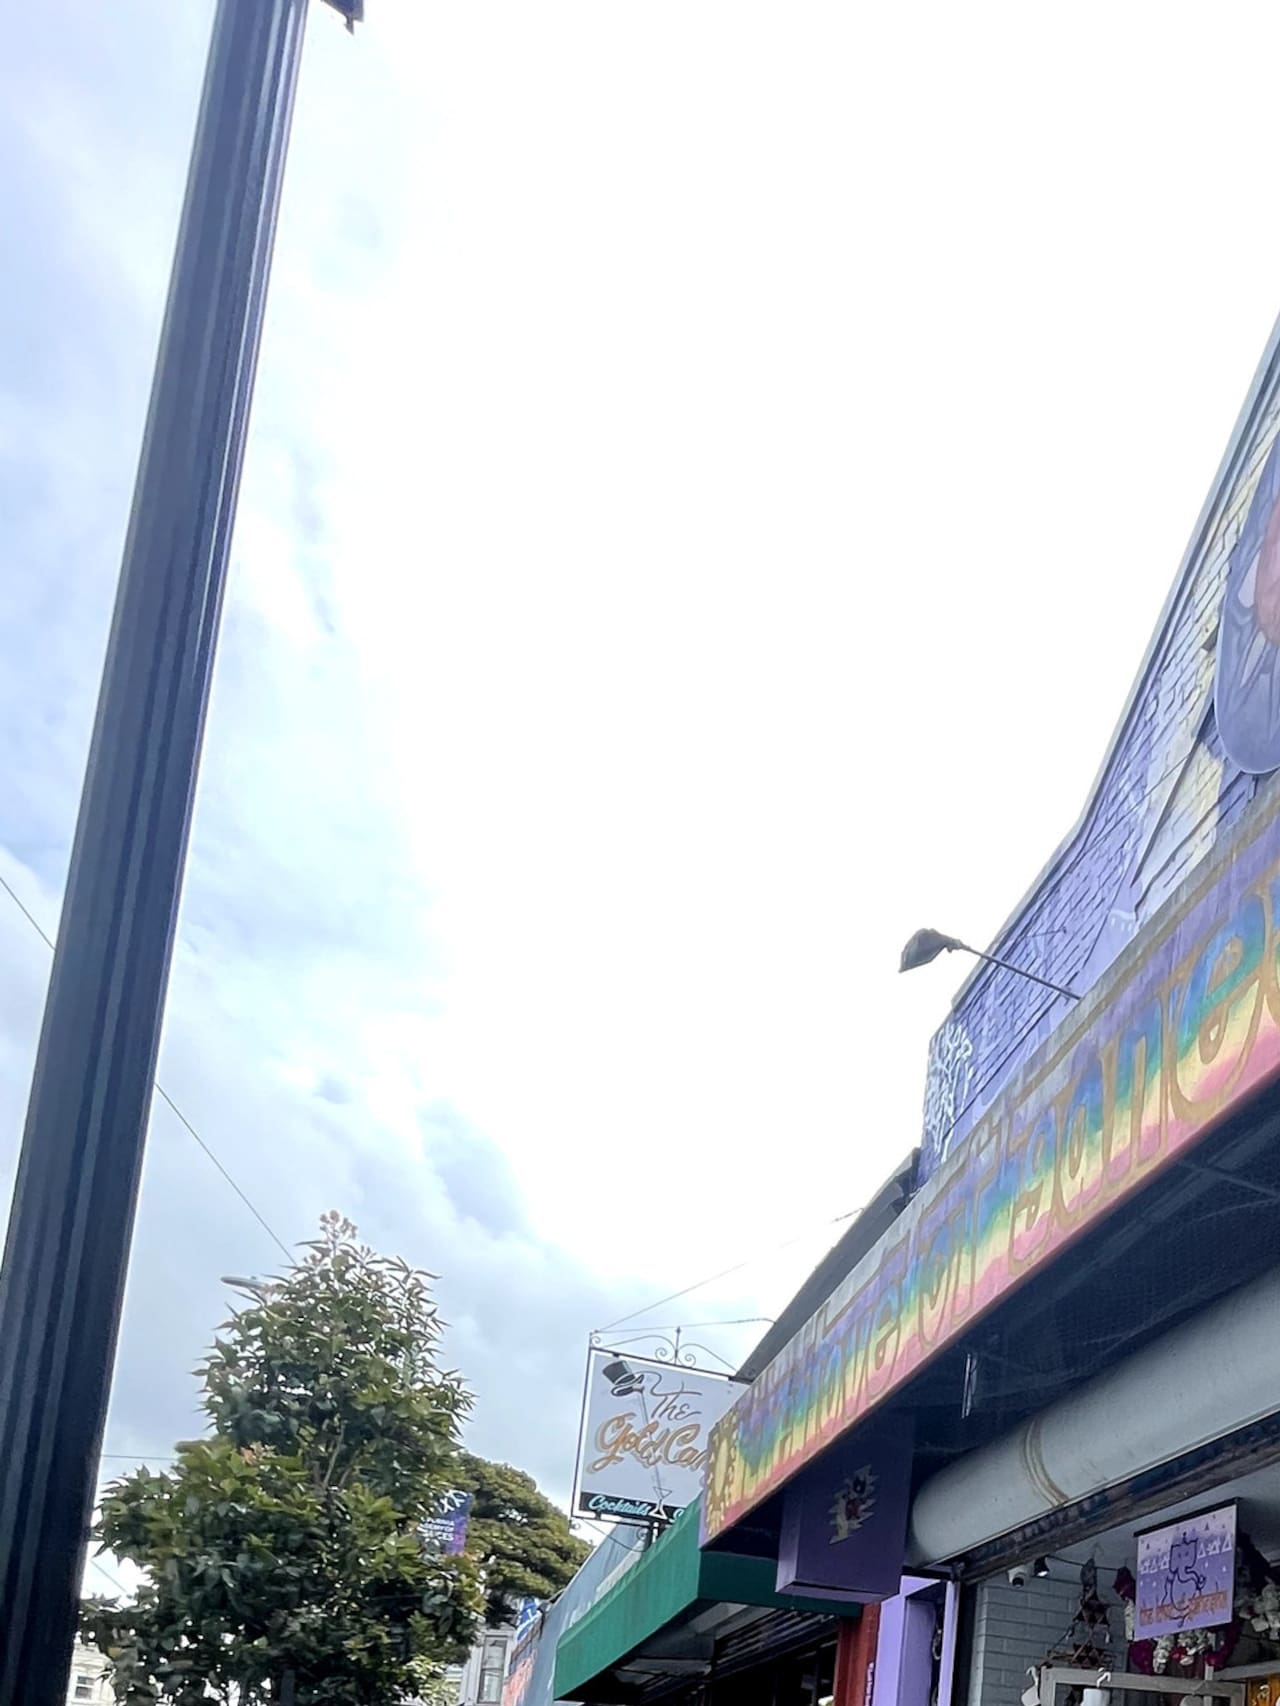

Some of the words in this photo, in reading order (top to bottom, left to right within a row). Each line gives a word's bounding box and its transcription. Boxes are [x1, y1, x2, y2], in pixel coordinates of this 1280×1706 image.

[648, 1370, 703, 1421] The
[591, 1411, 671, 1472] Gold
[588, 1495, 651, 1517] Cocktails
